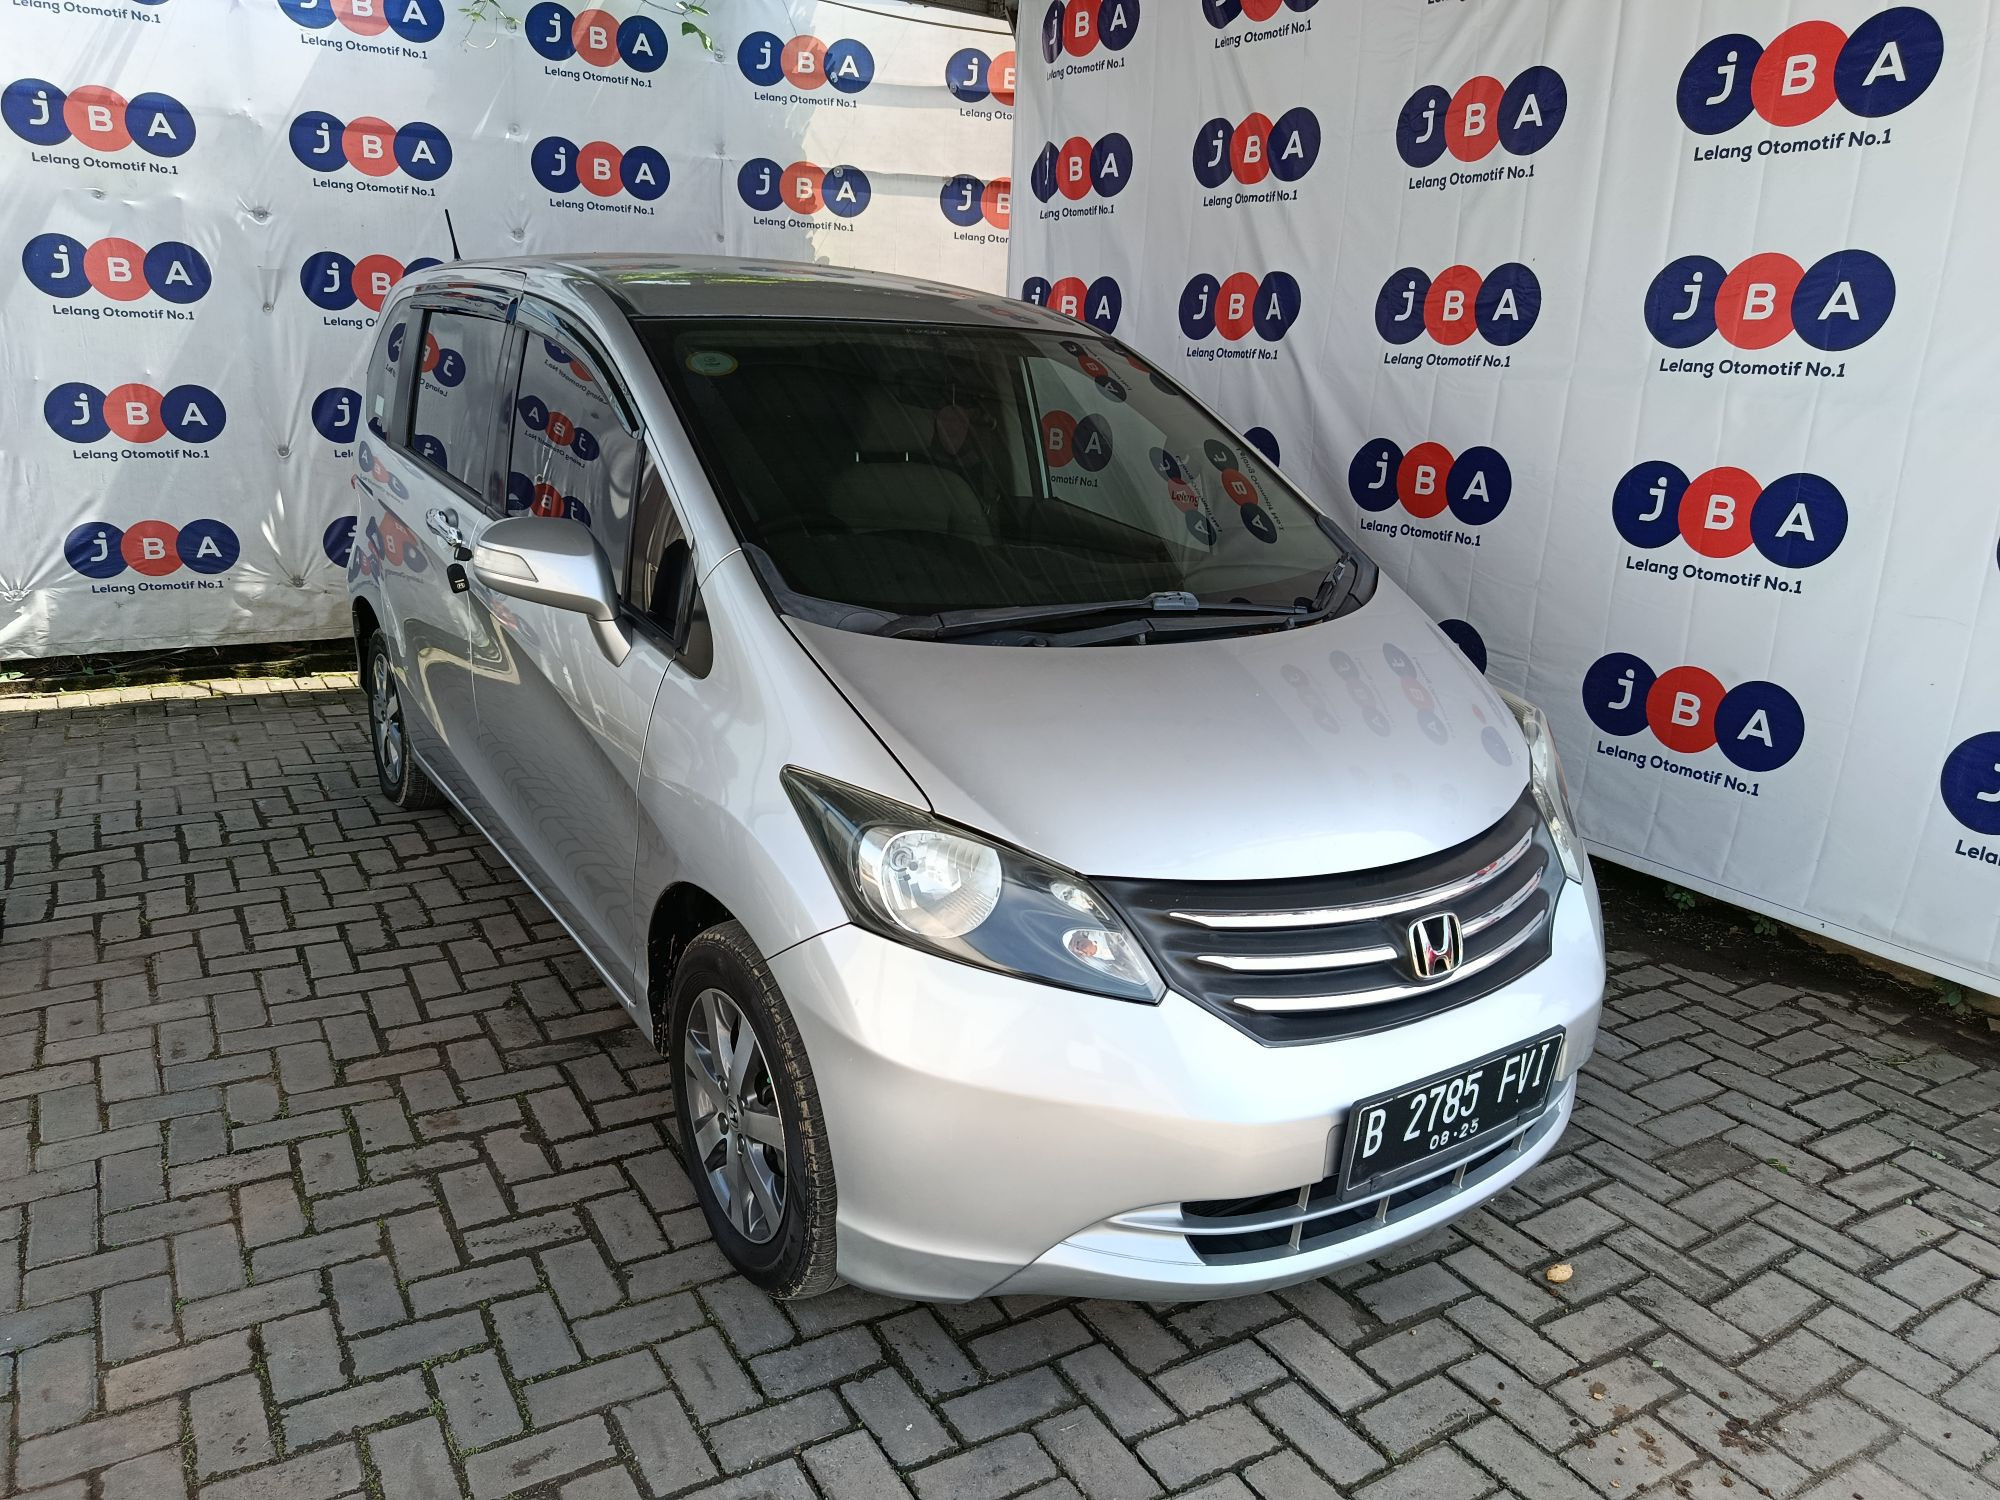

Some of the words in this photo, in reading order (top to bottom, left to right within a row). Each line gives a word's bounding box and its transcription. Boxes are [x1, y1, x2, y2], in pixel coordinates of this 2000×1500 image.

[64, 2, 128, 18] Otomotif
[131, 10, 160, 23] No.1
[1244, 24, 1290, 43] Otomotif
[1291, 19, 1312, 34] No.1
[301, 34, 342, 52] Lelang
[346, 40, 400, 56] Otomotif
[403, 48, 428, 59] No.1
[1066, 60, 1105, 75] Otomotif
[1107, 57, 1125, 70] No.1
[545, 66, 580, 82] Lelang
[582, 71, 629, 85] Otomotif
[631, 77, 652, 88] No.1
[754, 92, 787, 105] Lelang
[790, 95, 834, 106] Otomotif
[836, 98, 856, 108] No.1
[960, 108, 991, 121] Lelang
[1694, 145, 1752, 162] Lelang
[1758, 132, 1846, 155] Otomotif
[1848, 128, 1891, 147] No.1
[32, 152, 80, 169] Lelang
[83, 157, 146, 171] Otomotif
[149, 163, 178, 174] No.1
[1409, 176, 1447, 191] Lelang
[1450, 167, 1504, 185] Otomotif
[1507, 164, 1534, 179] No.1
[313, 178, 353, 193] Lelang
[356, 182, 409, 194] Otomotif
[412, 186, 436, 196] No.1
[550, 198, 584, 212] Lelang
[587, 201, 632, 213] Otomotif
[634, 205, 654, 215] No.1
[1203, 195, 1233, 208] Lelang
[1235, 190, 1276, 206] Otomotif
[1277, 189, 1297, 202] No.1
[1062, 205, 1098, 217] Otomotif
[1099, 204, 1114, 215] No.1
[754, 216, 787, 230] Lelang
[788, 216, 832, 230] Otomotif
[834, 222, 854, 232] No.1
[954, 232, 985, 244] Lelang
[53, 305, 100, 319] Lelang
[103, 307, 164, 318] Otomotif
[167, 310, 194, 320] No.1
[324, 317, 363, 329] Lelang
[1186, 347, 1214, 361] Lelang
[1216, 347, 1257, 360] Otomotif
[1258, 348, 1278, 360] No.1
[1384, 352, 1424, 369] Lelang
[1426, 354, 1482, 366] Otomotif
[1483, 355, 1510, 367] No.1
[1659, 358, 1714, 378] Lelang
[1719, 360, 1803, 376] Otomotif
[1805, 362, 1845, 377] No.1
[73, 450, 118, 462] Lelang
[121, 449, 180, 458] Otomotif
[182, 450, 209, 458] No.1
[1360, 518, 1398, 538] Lelang
[1400, 524, 1454, 542] Otomotif
[1454, 532, 1480, 546] No.1
[1626, 556, 1678, 580] Lelang
[1683, 564, 1762, 587] Otomotif
[1764, 576, 1802, 594] No.1
[92, 583, 135, 595] Lelang
[138, 581, 195, 592] Otomotif
[198, 580, 224, 589] No.1
[1597, 740, 1647, 769] Lelang
[1650, 755, 1723, 785] Otomotif
[1724, 775, 1760, 797] No.1
[1363, 1108, 1387, 1159] B
[1403, 1070, 1484, 1142] 2785
